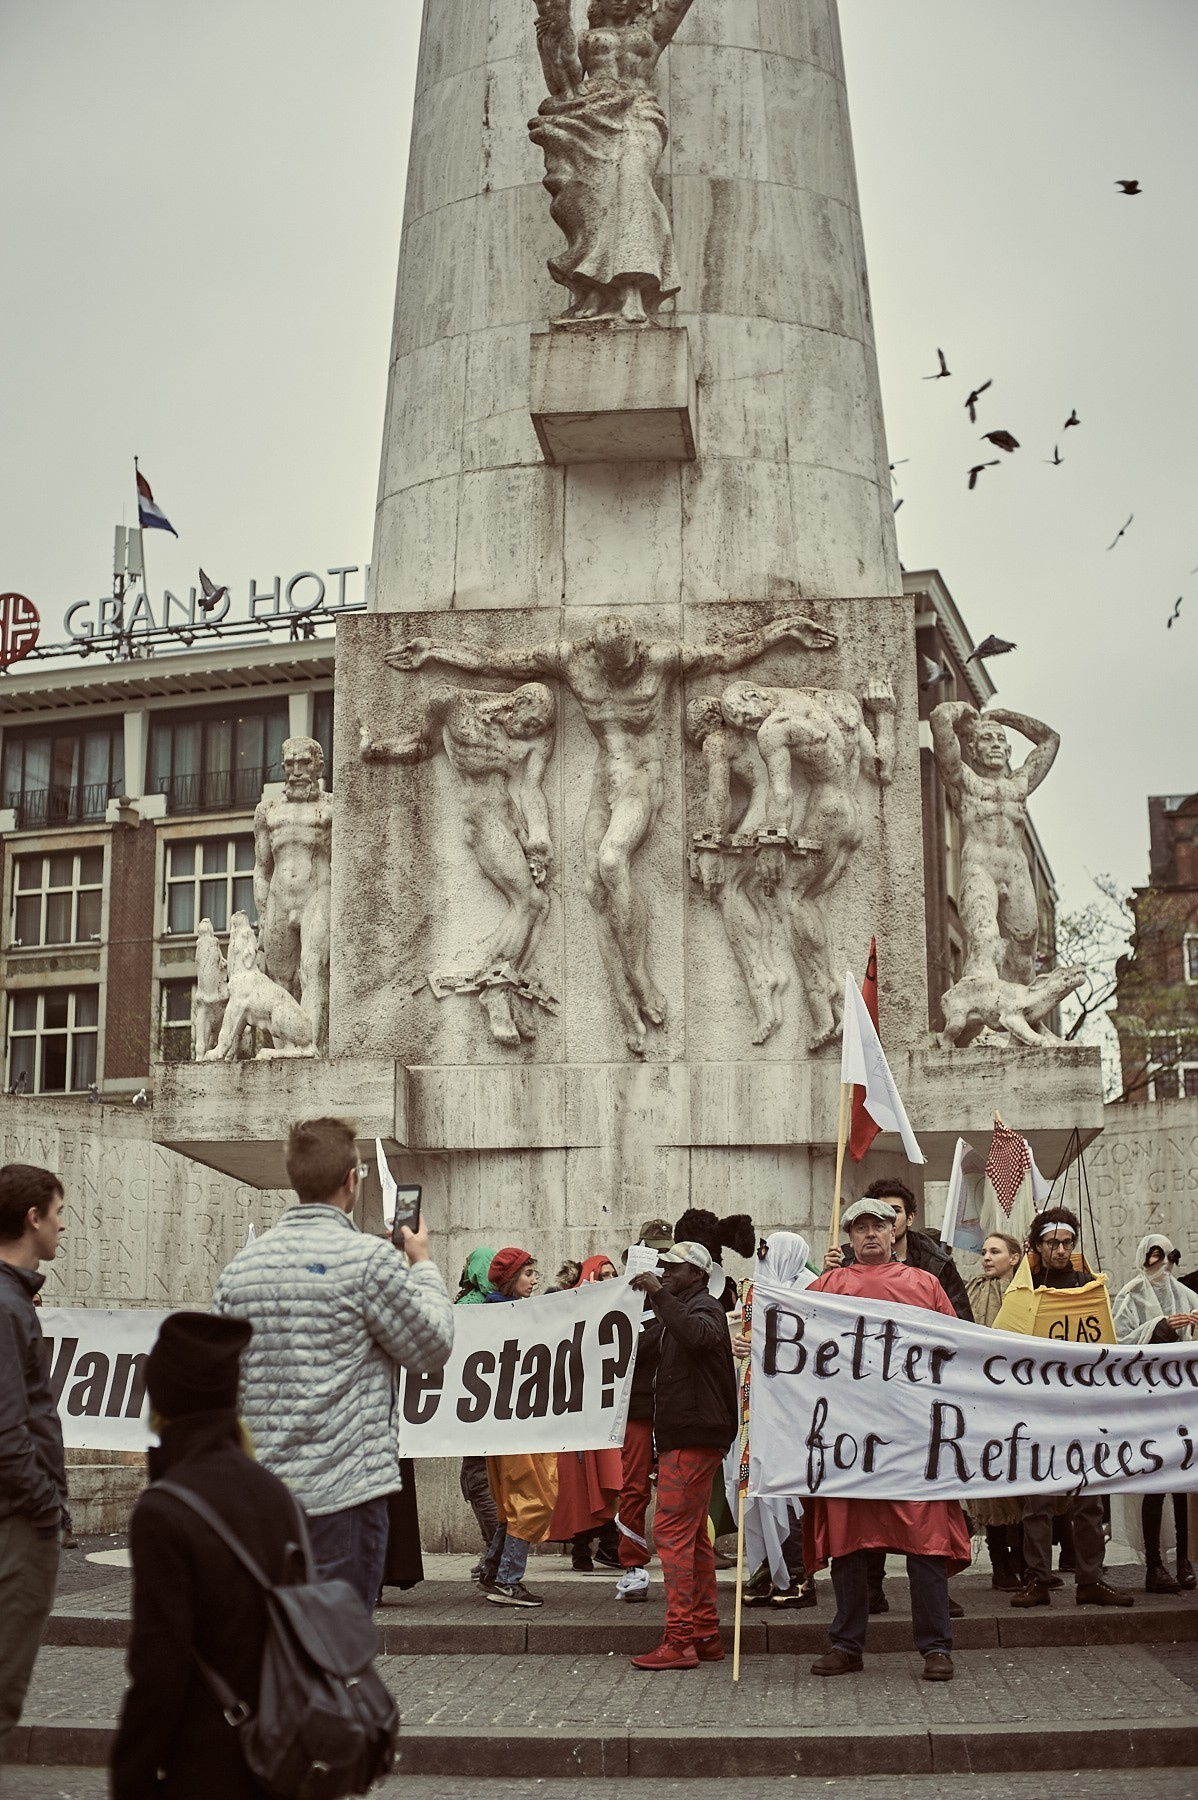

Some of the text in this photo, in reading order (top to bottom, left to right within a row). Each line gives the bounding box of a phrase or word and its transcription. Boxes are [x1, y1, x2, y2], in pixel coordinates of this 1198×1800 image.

[63, 585, 231, 640] GRAND
[82, 1174, 169, 1203] NOCH
[764, 1303, 957, 1384] Better
[805, 1397, 893, 1494] for
[924, 1400, 1164, 1496] Refugees
